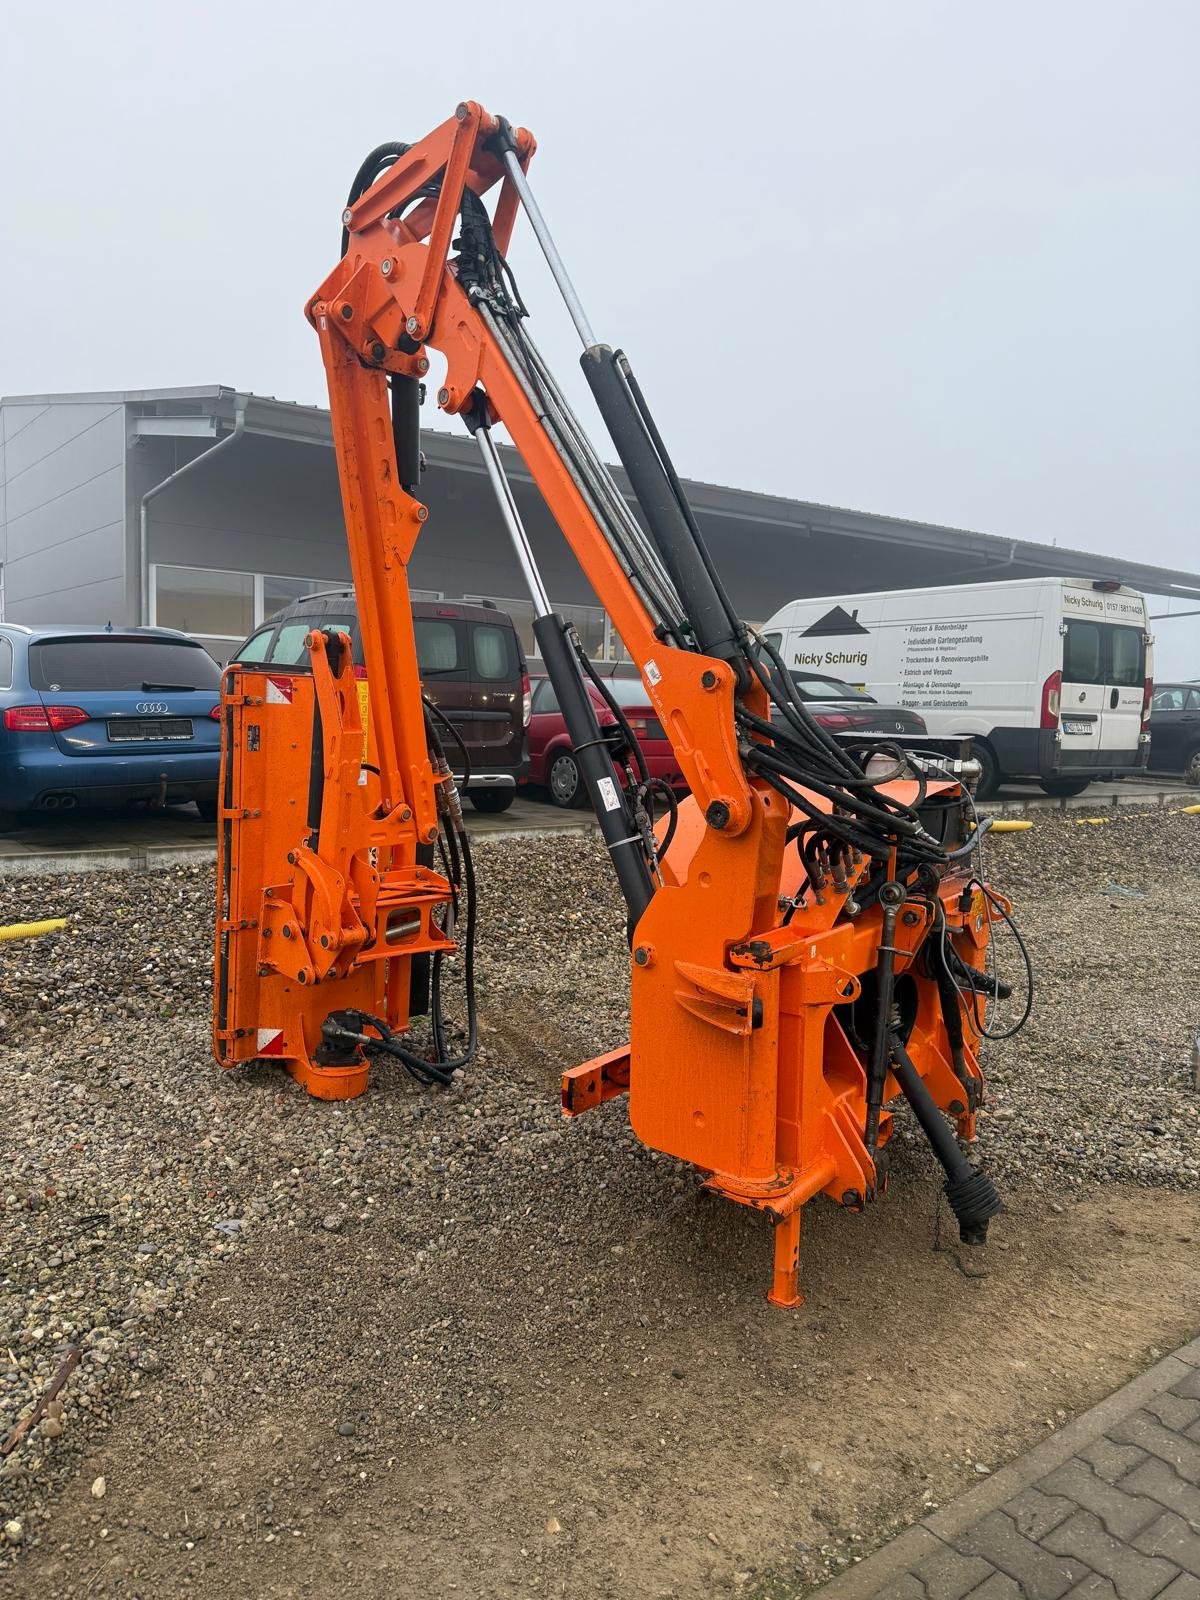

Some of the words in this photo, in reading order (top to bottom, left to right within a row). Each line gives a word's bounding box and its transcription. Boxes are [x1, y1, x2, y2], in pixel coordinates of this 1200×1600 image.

[1064, 594, 1080, 607] Nicky
[1081, 597, 1103, 611] Schurig
[909, 625, 928, 633] Fliesen
[908, 637, 937, 645] Individuelle
[937, 635, 983, 644] Gartengestaltung
[794, 653, 823, 667] Nicky
[825, 651, 868, 666] Schurig
[933, 668, 953, 676] Verputz
[902, 681, 925, 689] Montage
[931, 681, 961, 689] Demontage
[901, 699, 921, 707] Bagger-
